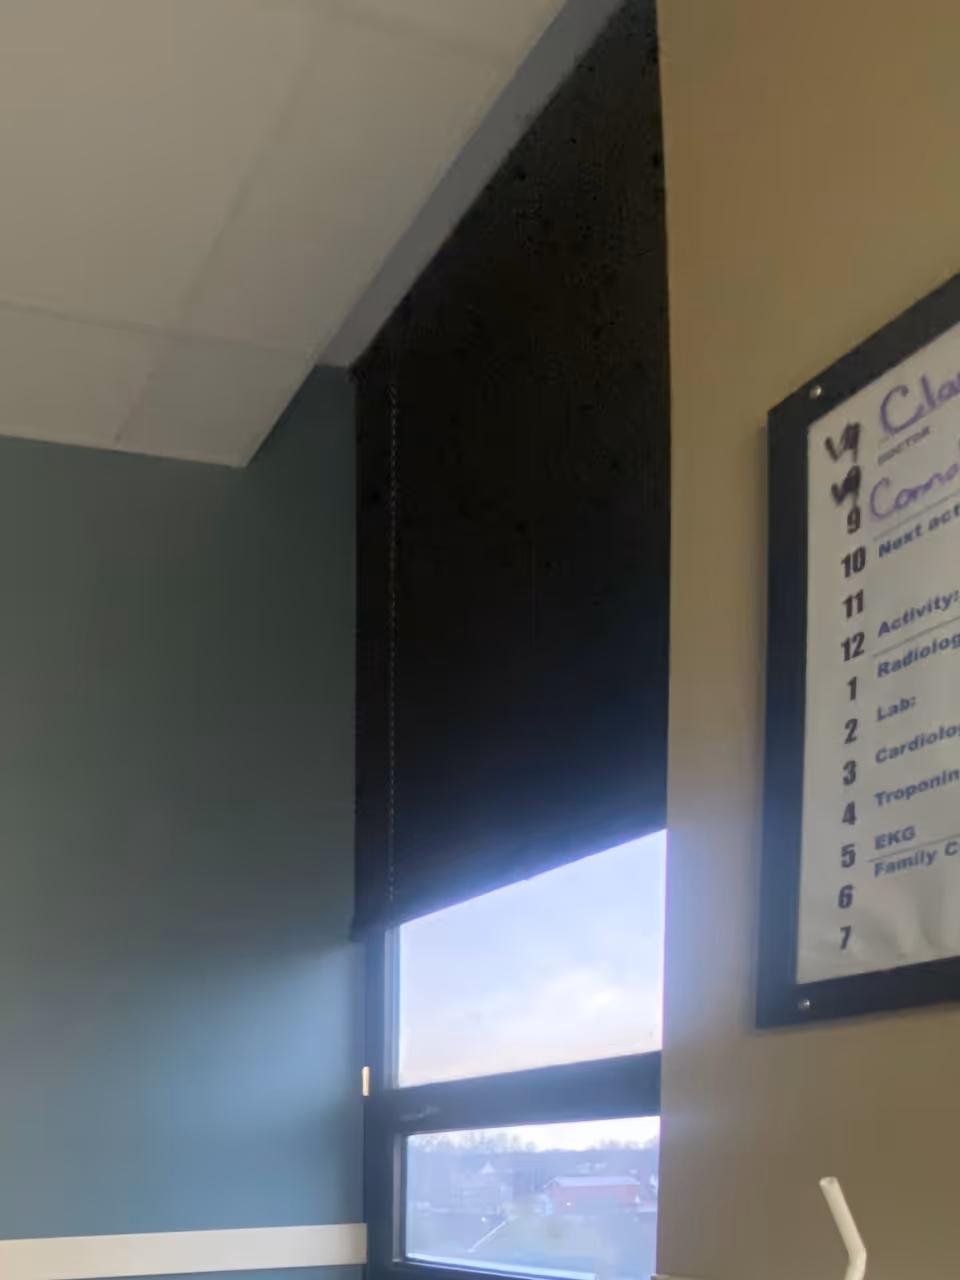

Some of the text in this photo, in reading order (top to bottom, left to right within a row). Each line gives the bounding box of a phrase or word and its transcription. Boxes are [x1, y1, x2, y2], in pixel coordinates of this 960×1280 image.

[846, 504, 861, 535] 9
[878, 524, 922, 559] Next
[840, 546, 866, 578] 10
[842, 588, 865, 619] 11
[878, 590, 959, 637] Activity:
[840, 632, 866, 662] 12
[846, 675, 858, 701] 1
[877, 696, 916, 721] Lab:
[844, 717, 859, 744] 2
[874, 724, 960, 764] Cardiolo
[842, 760, 857, 786] 3
[874, 768, 960, 807] Troponin
[842, 800, 857, 826] 4
[874, 825, 916, 851] EKG
[841, 843, 856, 869] 5
[874, 848, 937, 878] Family
[838, 884, 854, 910] 6
[839, 925, 852, 951] 7
